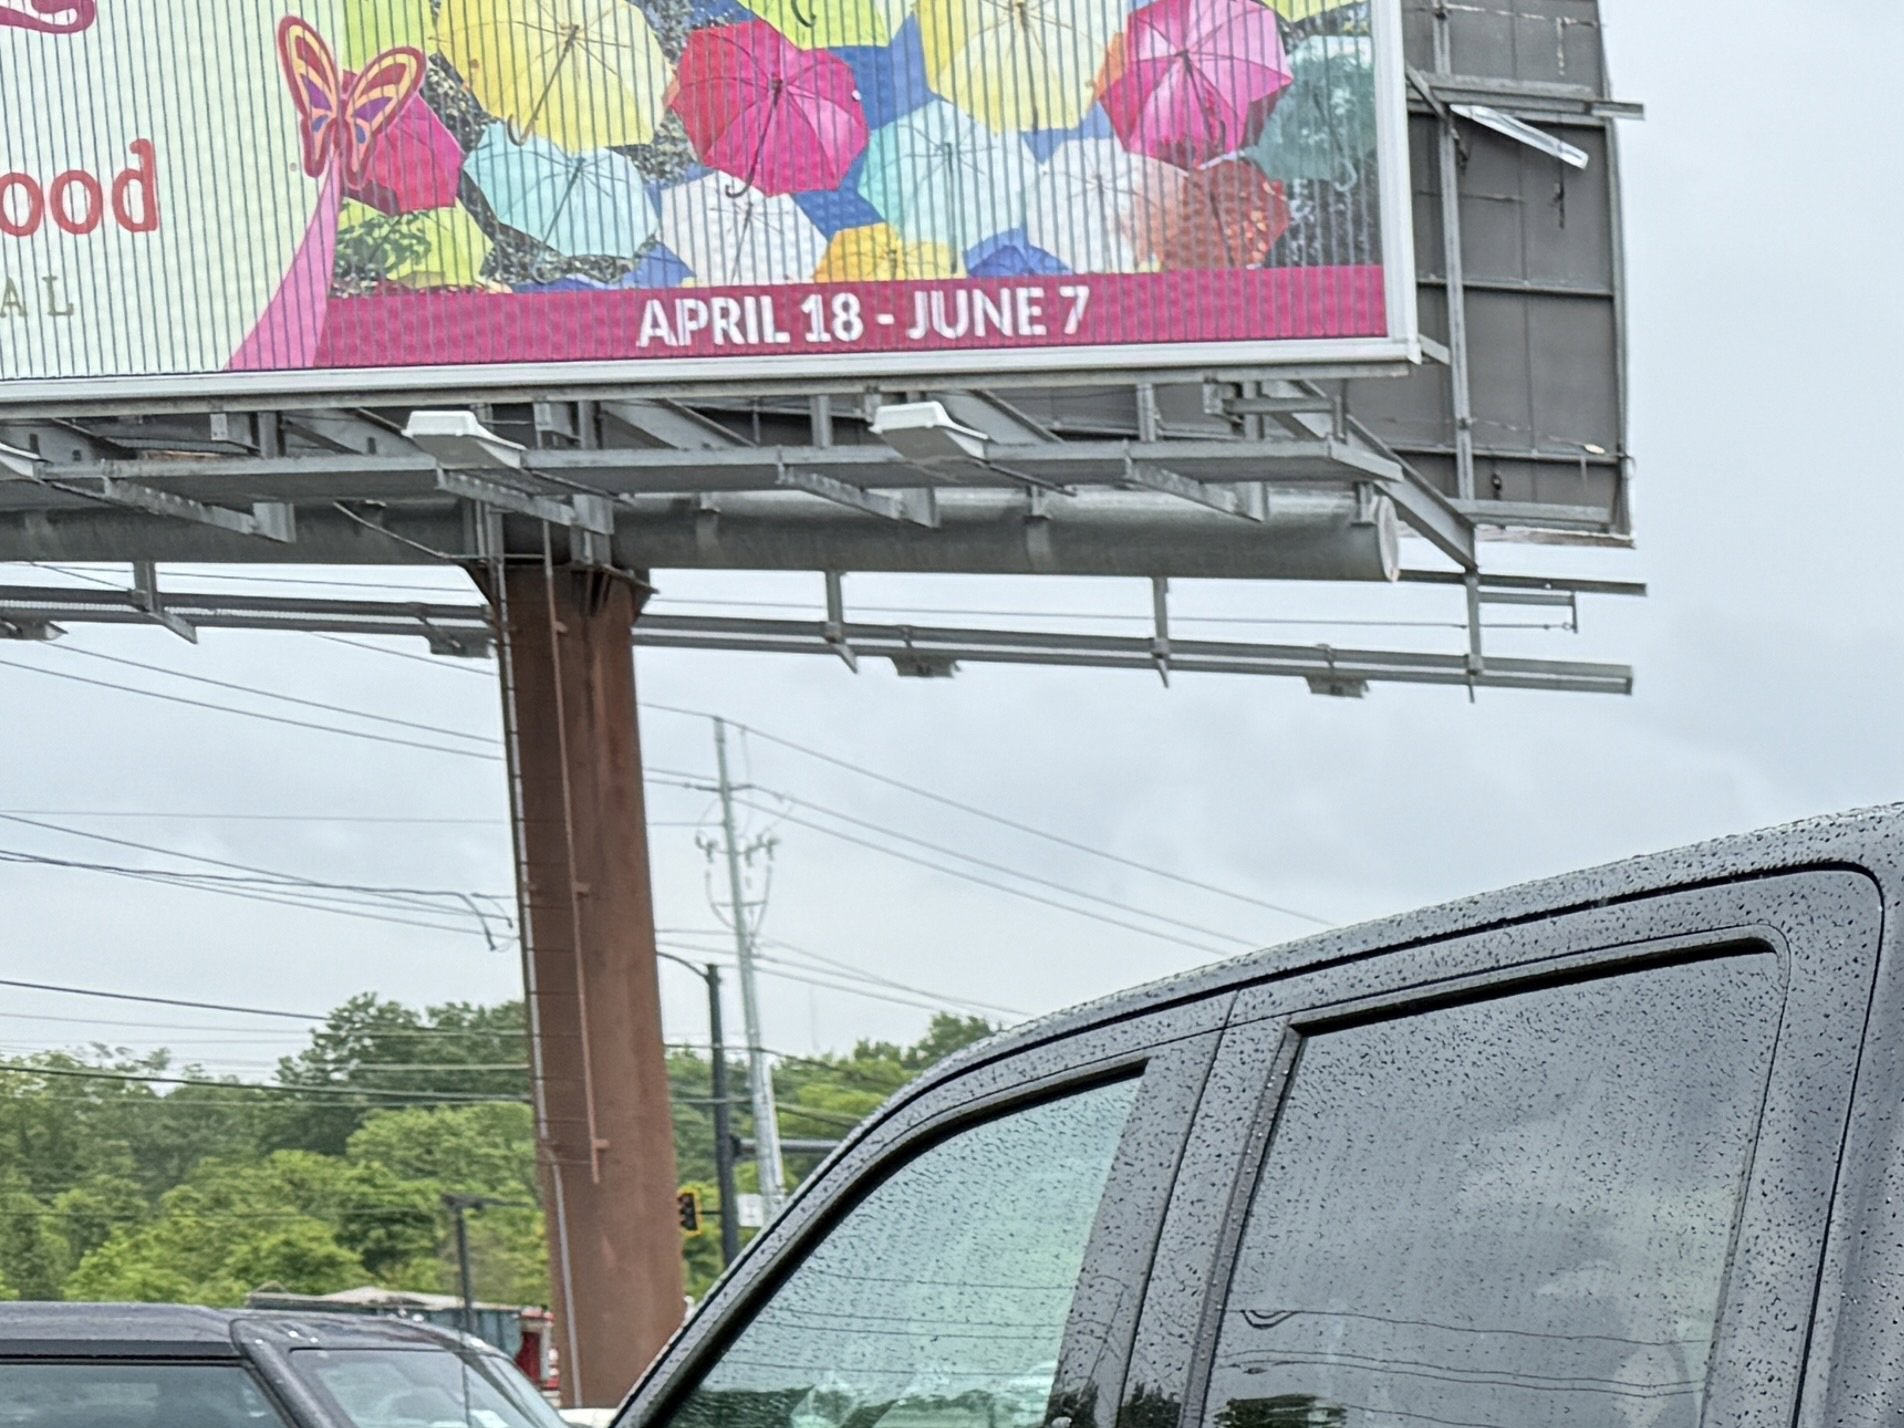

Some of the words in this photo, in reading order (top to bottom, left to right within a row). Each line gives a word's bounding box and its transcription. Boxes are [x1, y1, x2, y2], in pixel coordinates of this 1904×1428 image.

[636, 295, 790, 347] APRIL
[801, 292, 863, 342] 18
[906, 286, 1047, 340] JUNE
[1059, 285, 1090, 334] 7
